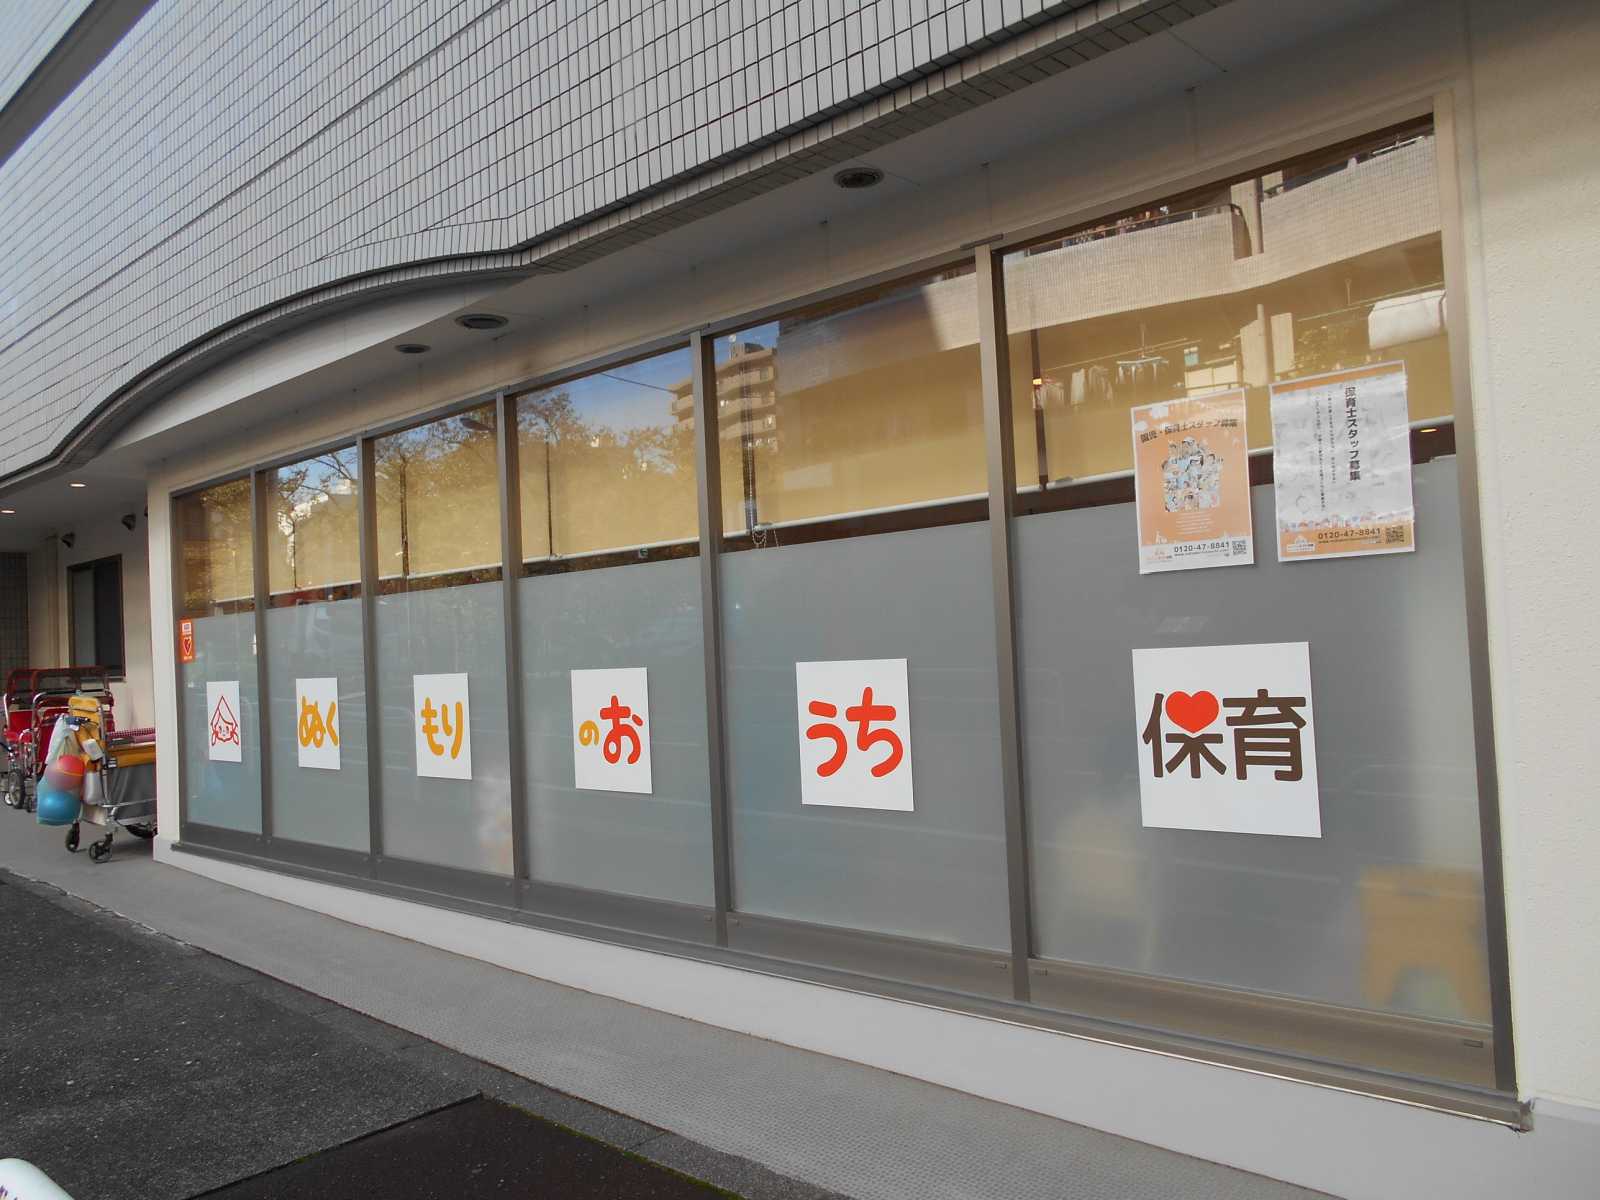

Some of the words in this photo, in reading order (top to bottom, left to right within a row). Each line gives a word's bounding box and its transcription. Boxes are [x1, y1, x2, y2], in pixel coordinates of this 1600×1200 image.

[1345, 386, 1361, 481] 保育士スタッフ募集
[298, 695, 339, 749] ぬく
[421, 693, 465, 760] もり
[806, 686, 904, 778] うち
[1142, 688, 1308, 782] 保育
